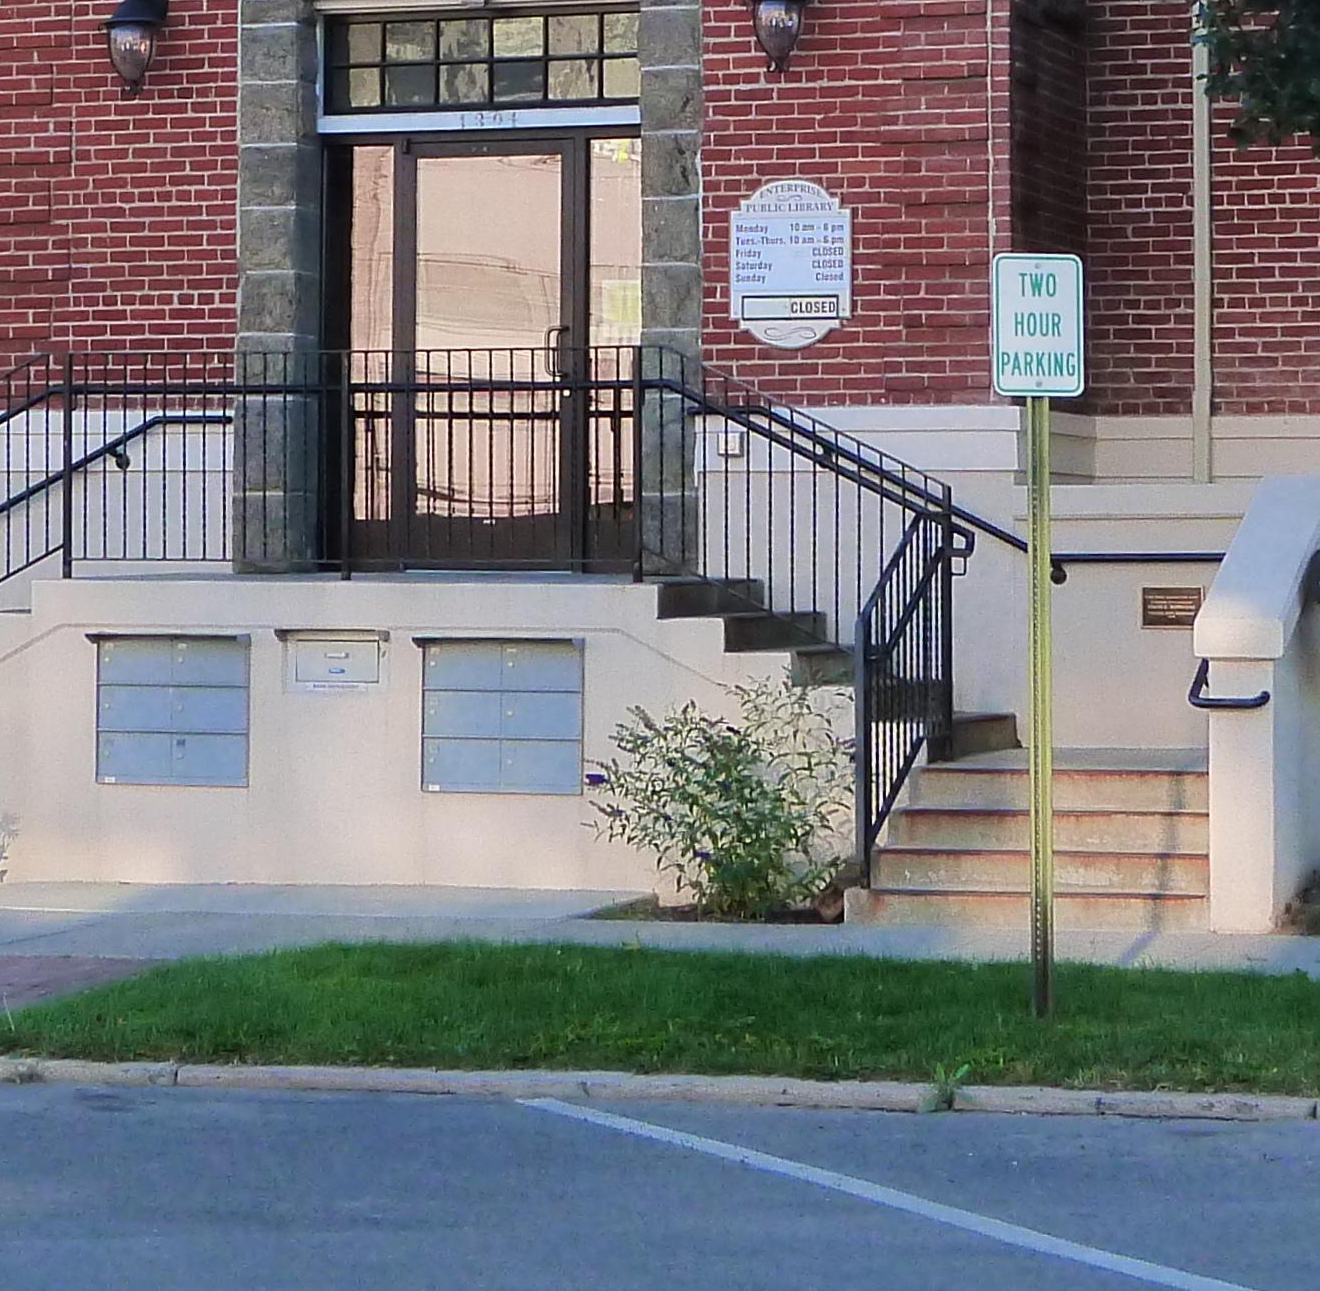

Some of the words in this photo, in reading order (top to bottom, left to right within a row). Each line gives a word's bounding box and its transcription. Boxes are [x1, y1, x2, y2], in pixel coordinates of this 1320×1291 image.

[759, 183, 822, 198] ENTERPRISE
[746, 203, 786, 213] PUBLIC
[788, 202, 834, 212] LIBRARY
[736, 224, 768, 234] Monday
[790, 223, 800, 231] 10
[831, 224, 844, 233] pm
[831, 237, 844, 245] pm
[736, 249, 762, 259] Friday
[812, 247, 844, 256] CLOSED
[736, 262, 772, 271] Saturday
[812, 260, 843, 268] CLOSED
[736, 274, 766, 284] Sunday
[815, 272, 844, 281] Closed
[1018, 272, 1057, 298] TWO
[790, 301, 836, 314] CLOSED
[1014, 312, 1062, 337] HOUR
[1001, 351, 1076, 377] PARKING
